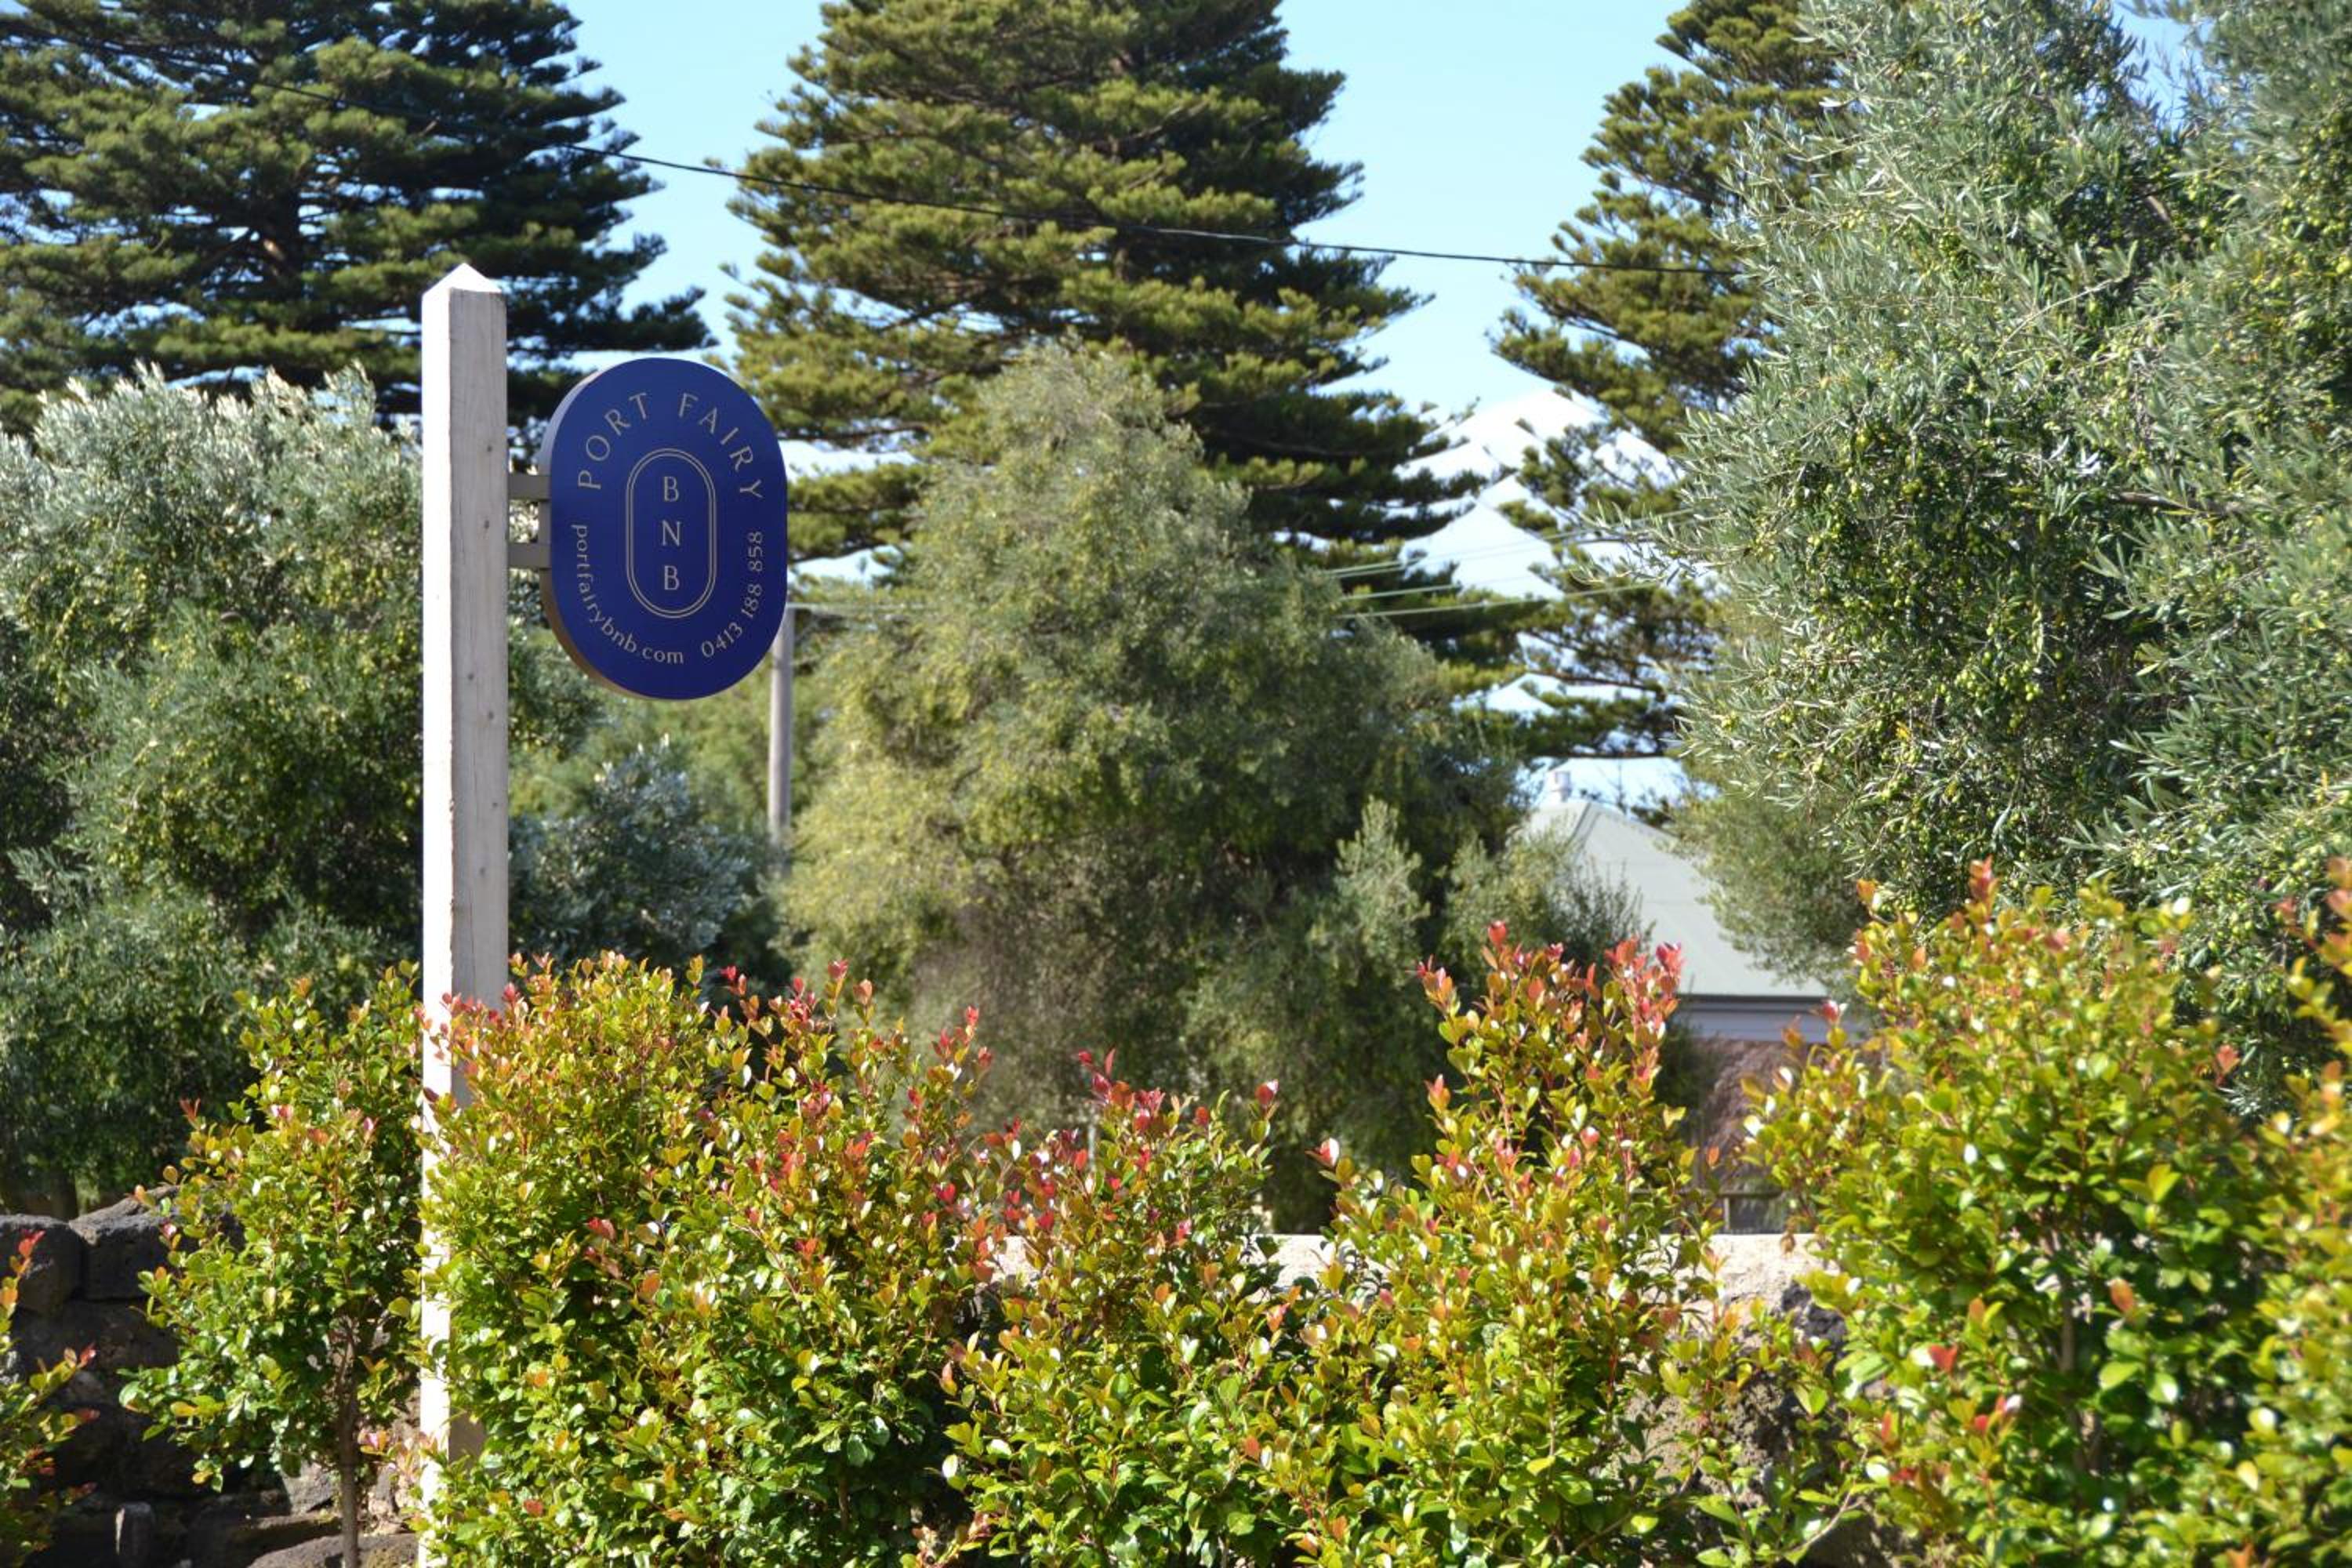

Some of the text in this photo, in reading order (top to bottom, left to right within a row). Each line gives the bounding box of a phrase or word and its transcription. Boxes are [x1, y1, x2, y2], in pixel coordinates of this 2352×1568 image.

[578, 393, 764, 499] PORT FAIRY
[571, 524, 684, 664] portfairybnb.com
[701, 531, 763, 659] 0413 188 858
